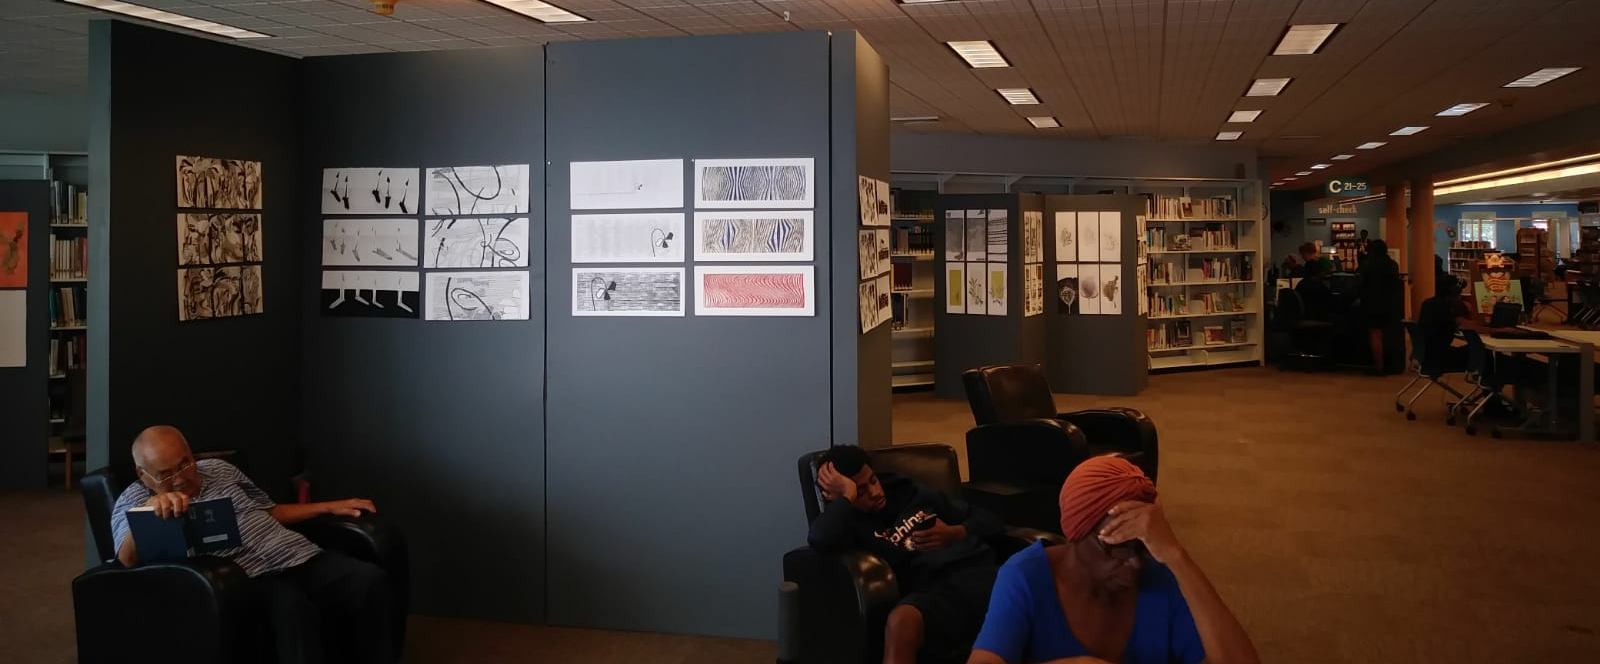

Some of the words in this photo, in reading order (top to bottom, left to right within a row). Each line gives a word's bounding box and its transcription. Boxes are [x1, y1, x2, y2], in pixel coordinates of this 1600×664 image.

[1329, 180, 1342, 193] C
[1344, 182, 1367, 190] 21-25
[1318, 204, 1357, 214] self-check
